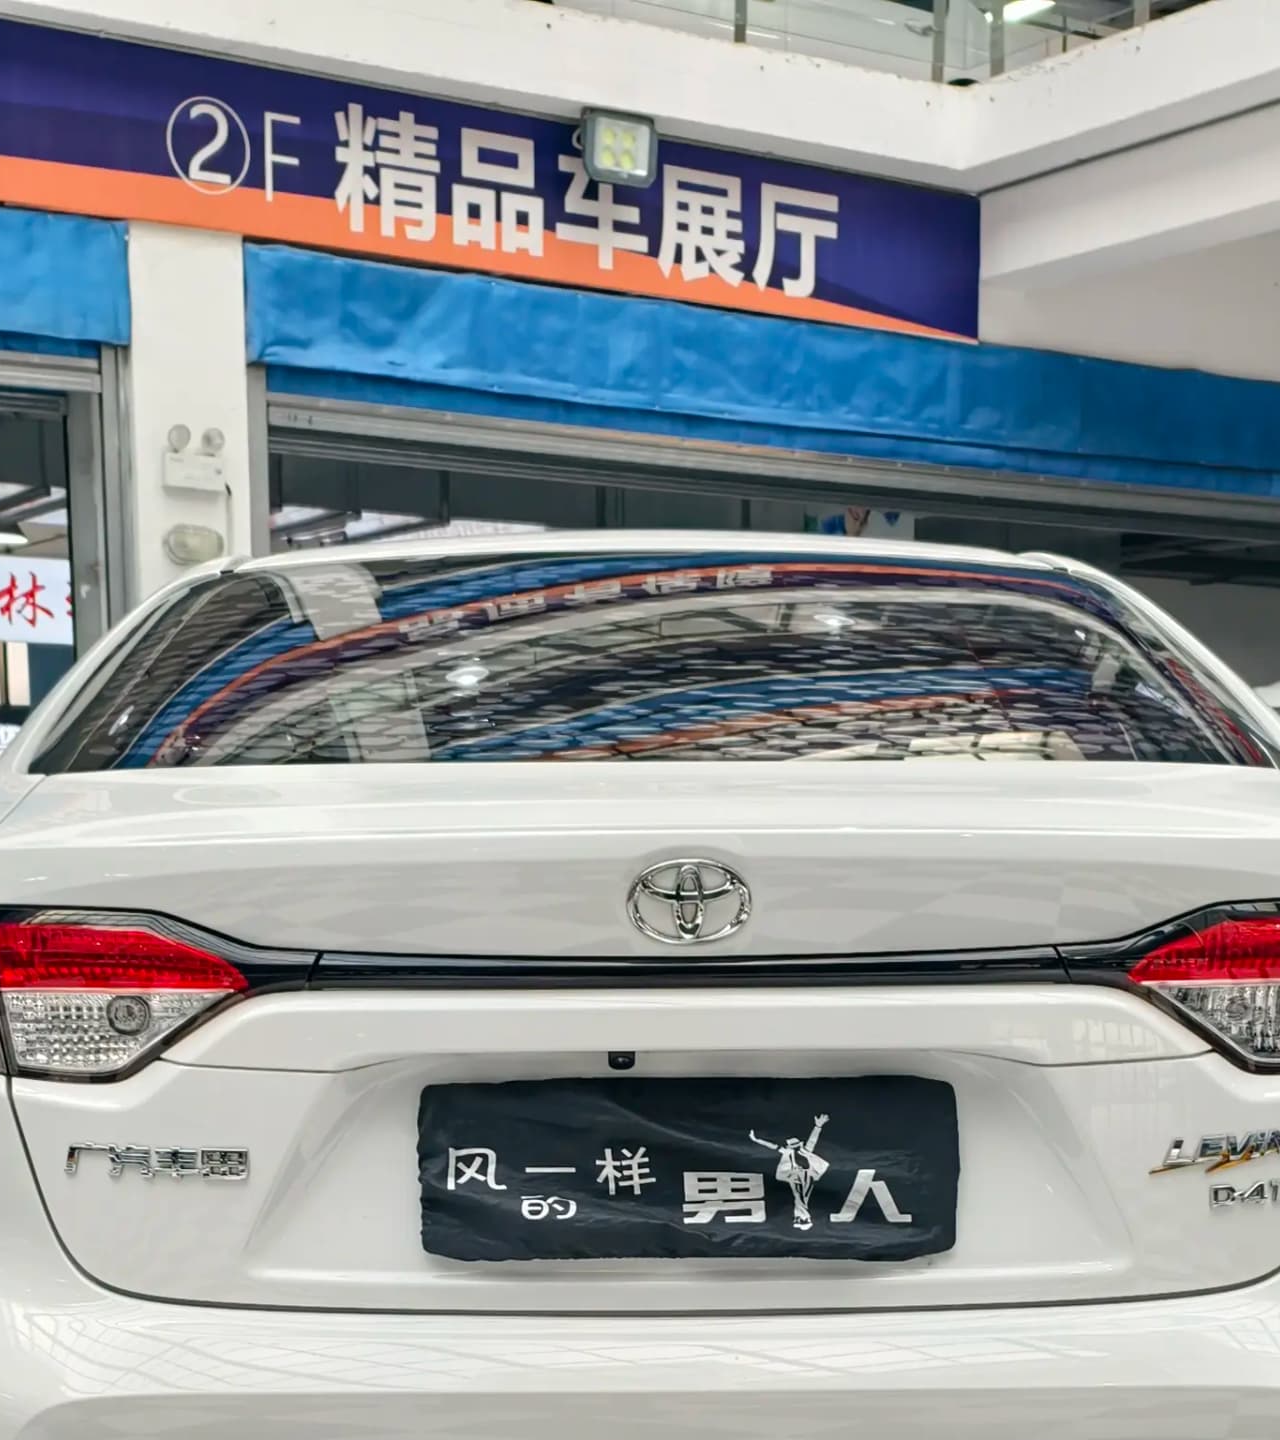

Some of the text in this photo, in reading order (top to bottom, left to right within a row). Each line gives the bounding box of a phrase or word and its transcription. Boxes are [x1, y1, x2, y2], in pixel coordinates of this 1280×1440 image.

[333, 102, 839, 299] 精品车展厅
[520, 1194, 578, 1222] 的
